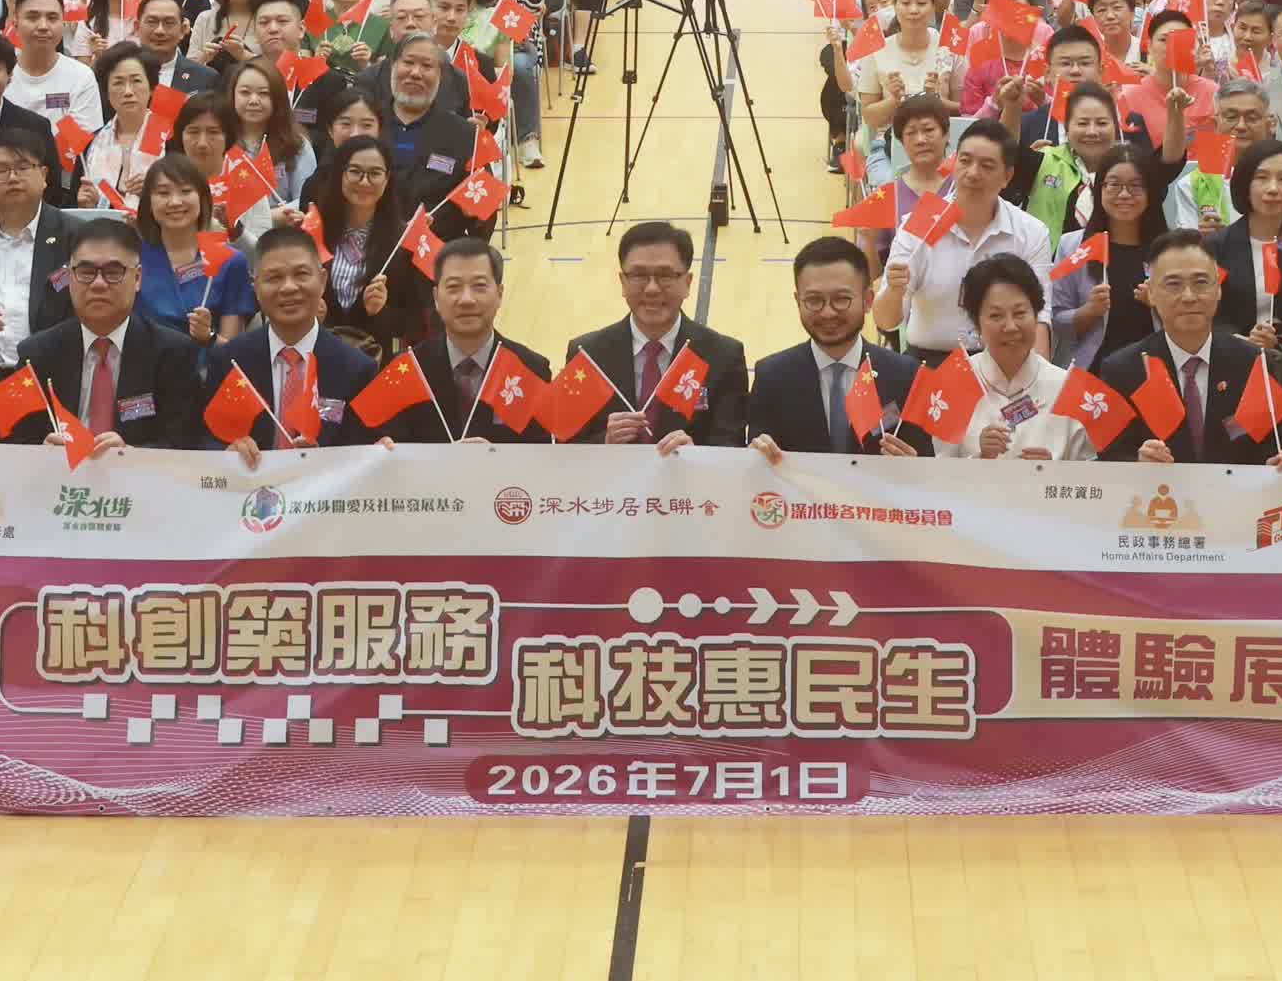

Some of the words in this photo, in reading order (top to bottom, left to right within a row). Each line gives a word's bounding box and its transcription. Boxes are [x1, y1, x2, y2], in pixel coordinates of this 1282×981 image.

[201, 476, 227, 490] 協辦
[1044, 486, 1103, 499] 撥款資助
[53, 484, 134, 518] 深水埗
[288, 498, 465, 515] 深水埗關愛及社區發展基金
[539, 496, 721, 516] 深水埗居民聯會
[791, 502, 953, 526] 深水埗各界慶典委員會
[1118, 535, 1206, 549] 民政事務總署
[1102, 552, 1130, 561] Home
[1132, 552, 1164, 561] Affairs
[1166, 552, 1225, 564] Department
[44, 589, 490, 675] 科創築服務
[522, 646, 969, 729] 科技惠民生
[487, 761, 848, 799] 2026年7月1日
